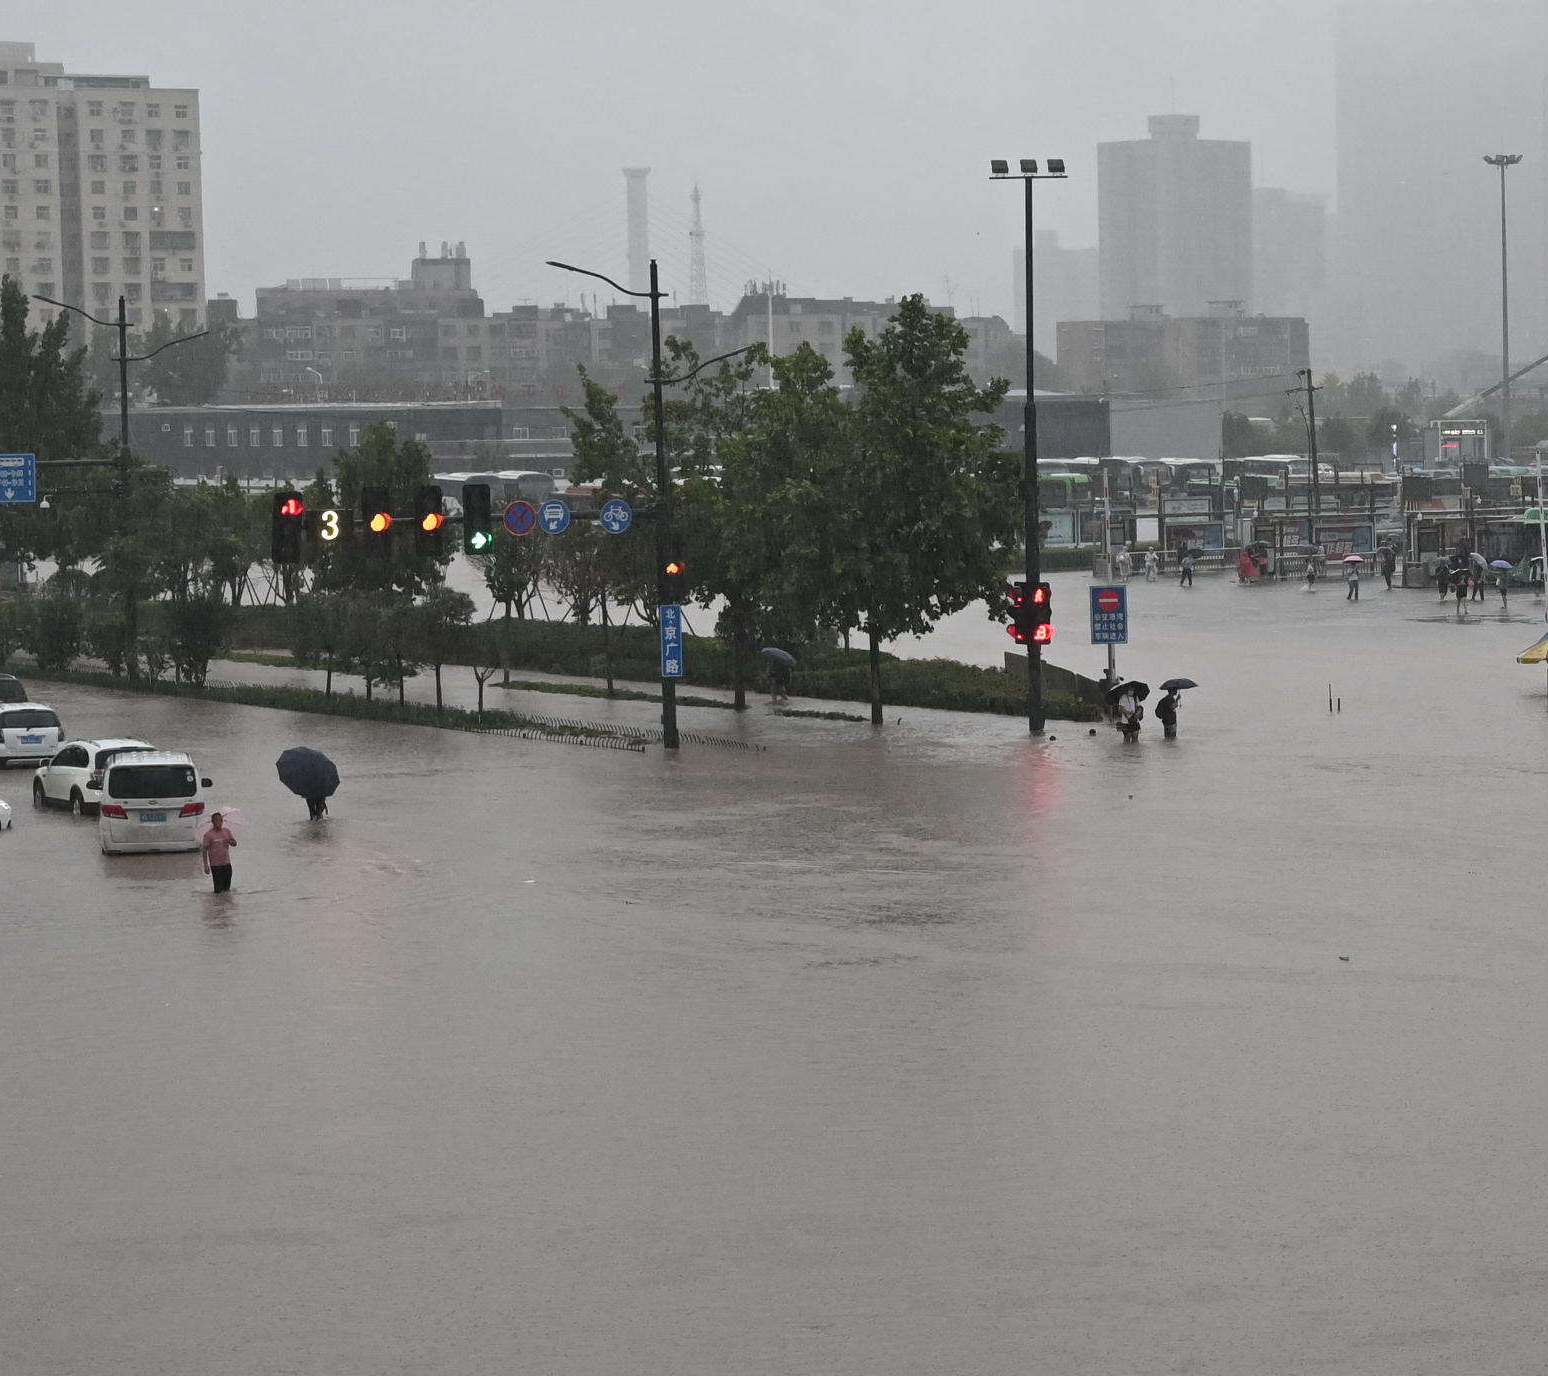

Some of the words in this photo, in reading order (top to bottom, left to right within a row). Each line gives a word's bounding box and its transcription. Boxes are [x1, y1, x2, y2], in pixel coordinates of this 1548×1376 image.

[321, 510, 339, 540] 3
[664, 626, 679, 674] 京广路
